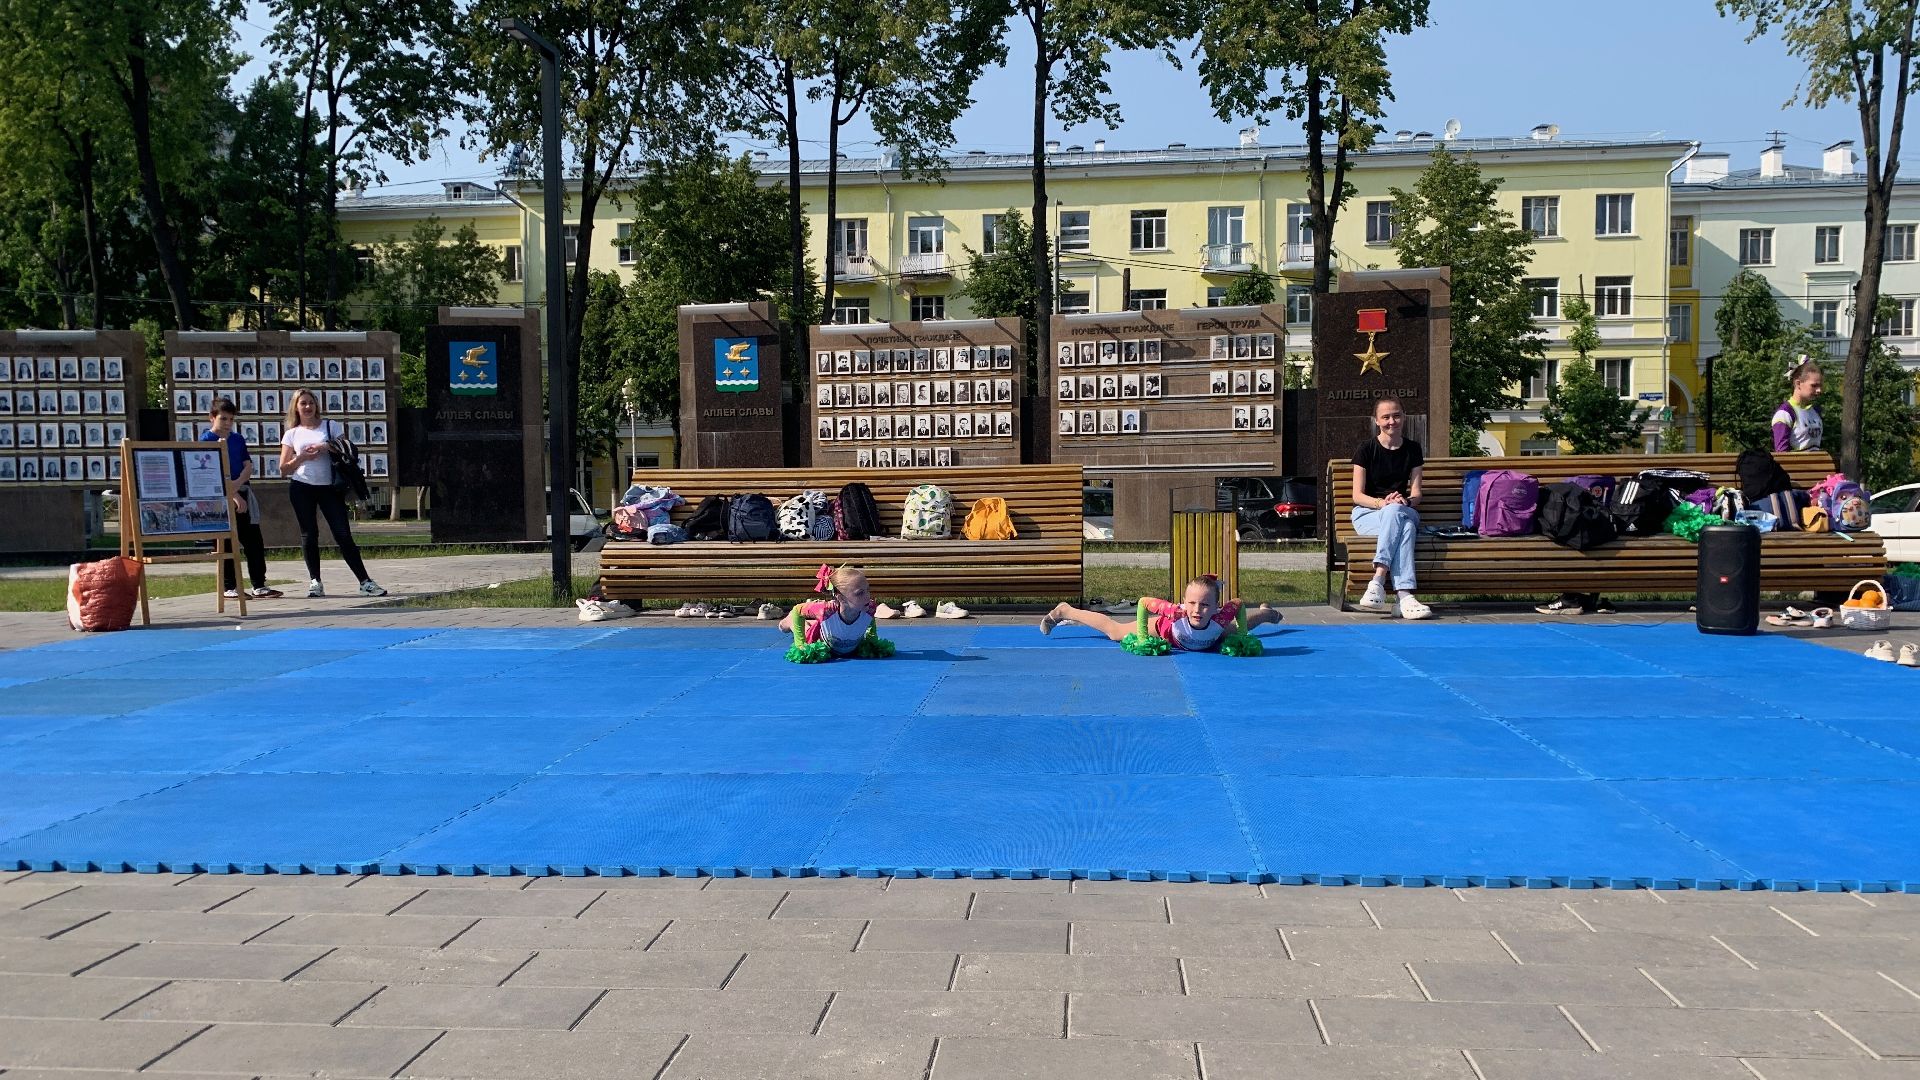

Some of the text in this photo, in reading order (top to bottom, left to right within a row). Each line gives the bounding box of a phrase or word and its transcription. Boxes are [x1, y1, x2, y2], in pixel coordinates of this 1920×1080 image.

[1122, 323, 1175, 334] ГРАЖДАНЕ
[1196, 319, 1260, 331] ГЕРОИ ТРУДА
[1327, 388, 1418, 400] АЛЛЕЯ СЛАВЫ
[435, 410, 514, 420] АЛЛЕЯ СЛАВЫ
[703, 407, 774, 418] АЛЛЕЯ СЛАВЫ
